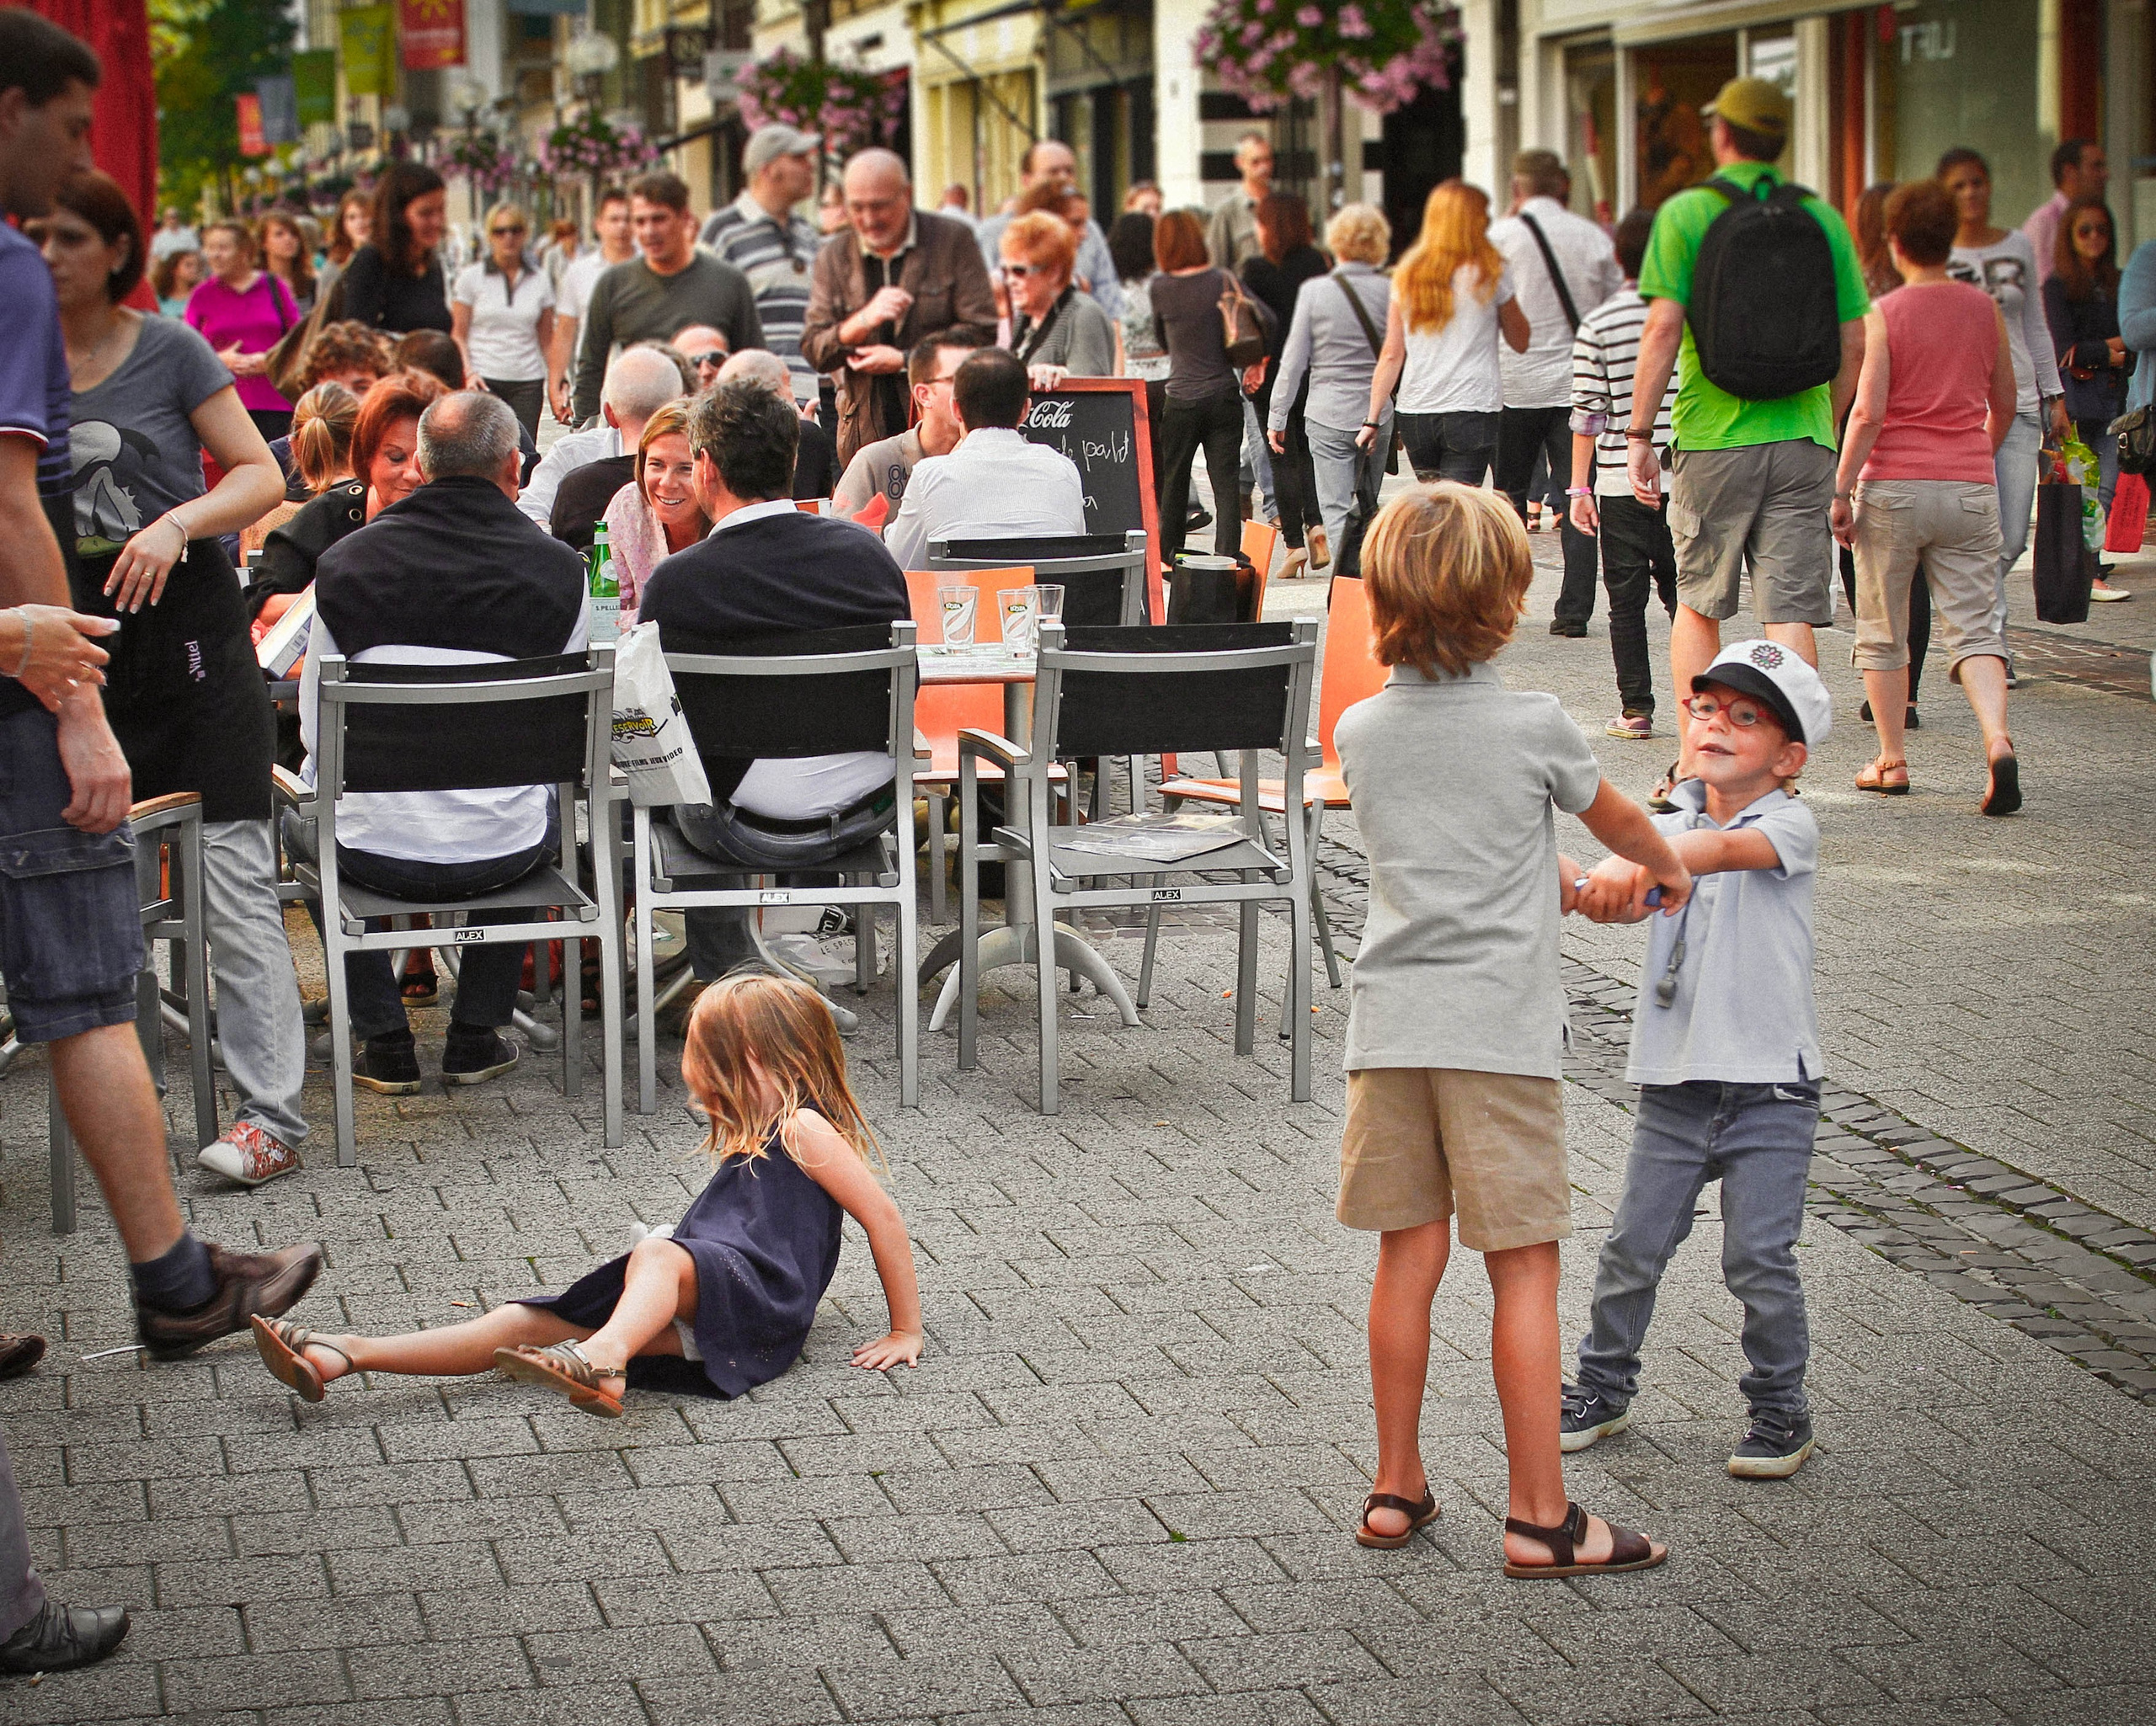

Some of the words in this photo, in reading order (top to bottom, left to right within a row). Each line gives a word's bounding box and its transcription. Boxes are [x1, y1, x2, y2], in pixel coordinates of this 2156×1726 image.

[184, 640, 202, 674] Vittel
[663, 747, 683, 763] VIDEO
[760, 892, 788, 903] ALEX
[1154, 890, 1179, 900] ALEX
[456, 930, 483, 941] ALEX
[820, 945, 830, 955] LE
